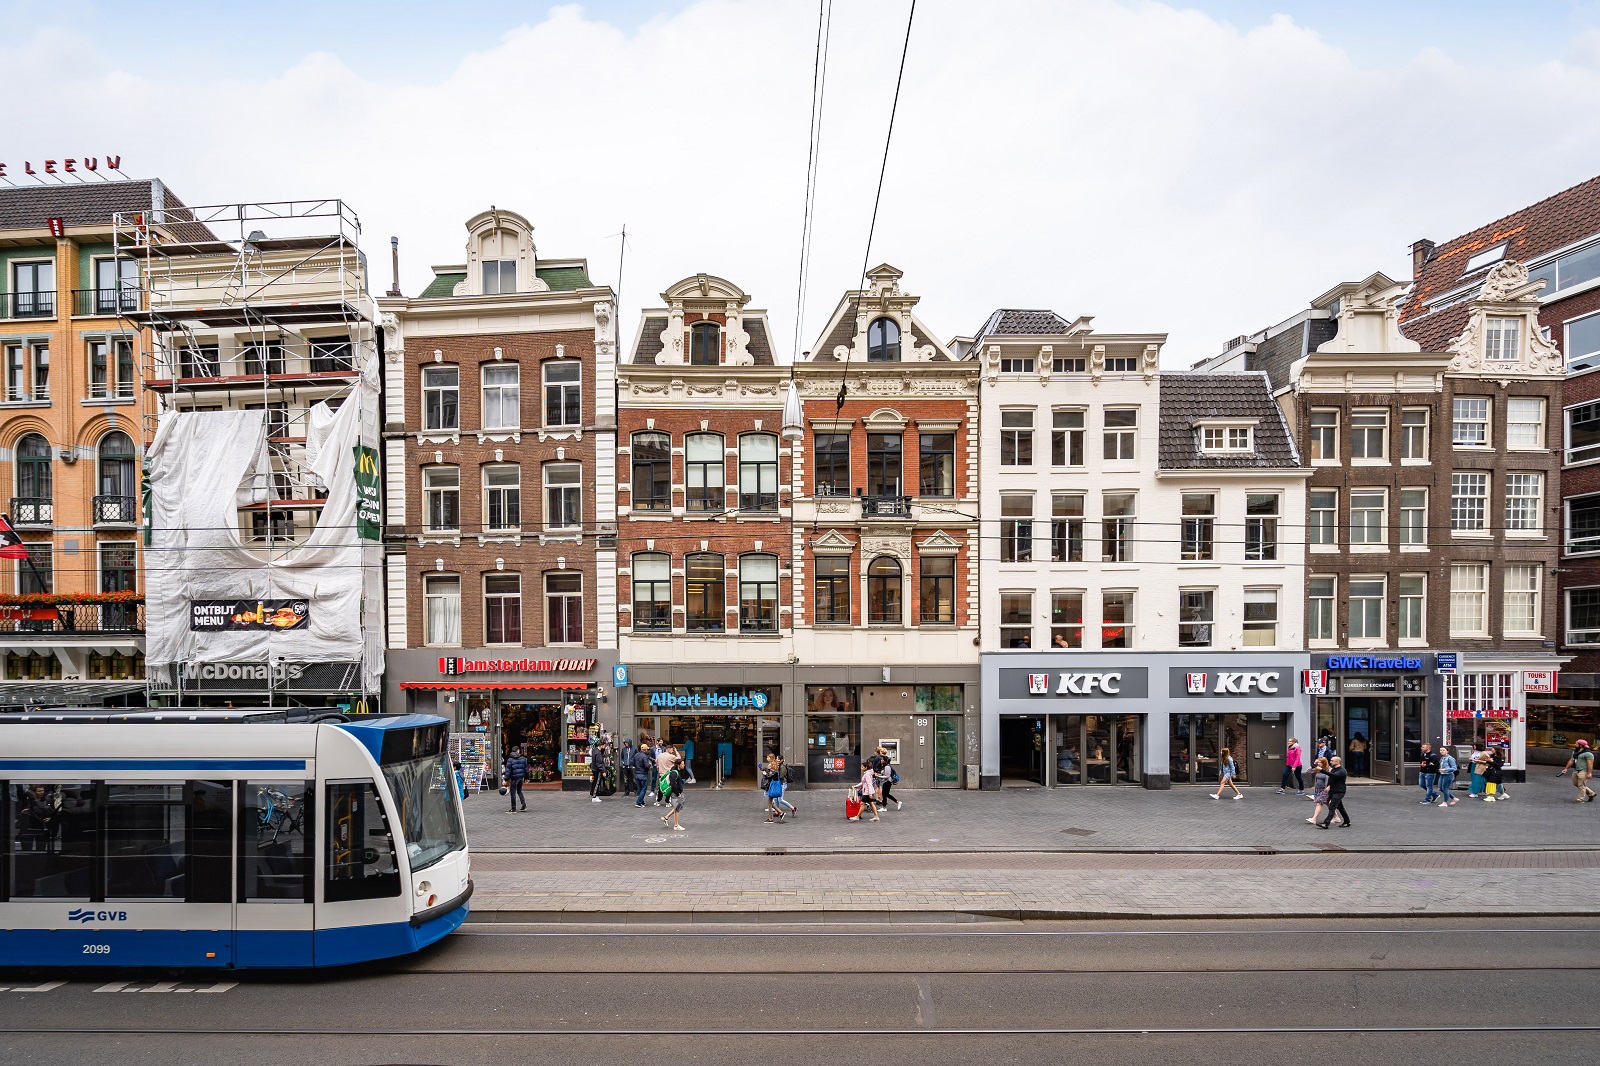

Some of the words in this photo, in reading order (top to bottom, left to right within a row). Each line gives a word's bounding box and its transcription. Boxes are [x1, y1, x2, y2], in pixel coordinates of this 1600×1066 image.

[25, 155, 121, 175] LEEUW
[193, 605, 236, 615] ONTBIJT
[194, 616, 224, 626] MENU
[1328, 656, 1364, 669] GWK
[1366, 655, 1422, 669] Travelex
[1056, 672, 1122, 694] KFC
[1213, 672, 1280, 694] KFC
[649, 692, 701, 707] Albert
[706, 692, 749, 709] Heijn
[1447, 709, 1474, 718] TOURS
[1475, 709, 1483, 718] &
[1485, 709, 1518, 718] TICKETS
[917, 718, 928, 727] 89
[97, 910, 127, 921] GVB
[82, 944, 111, 954] 2099
